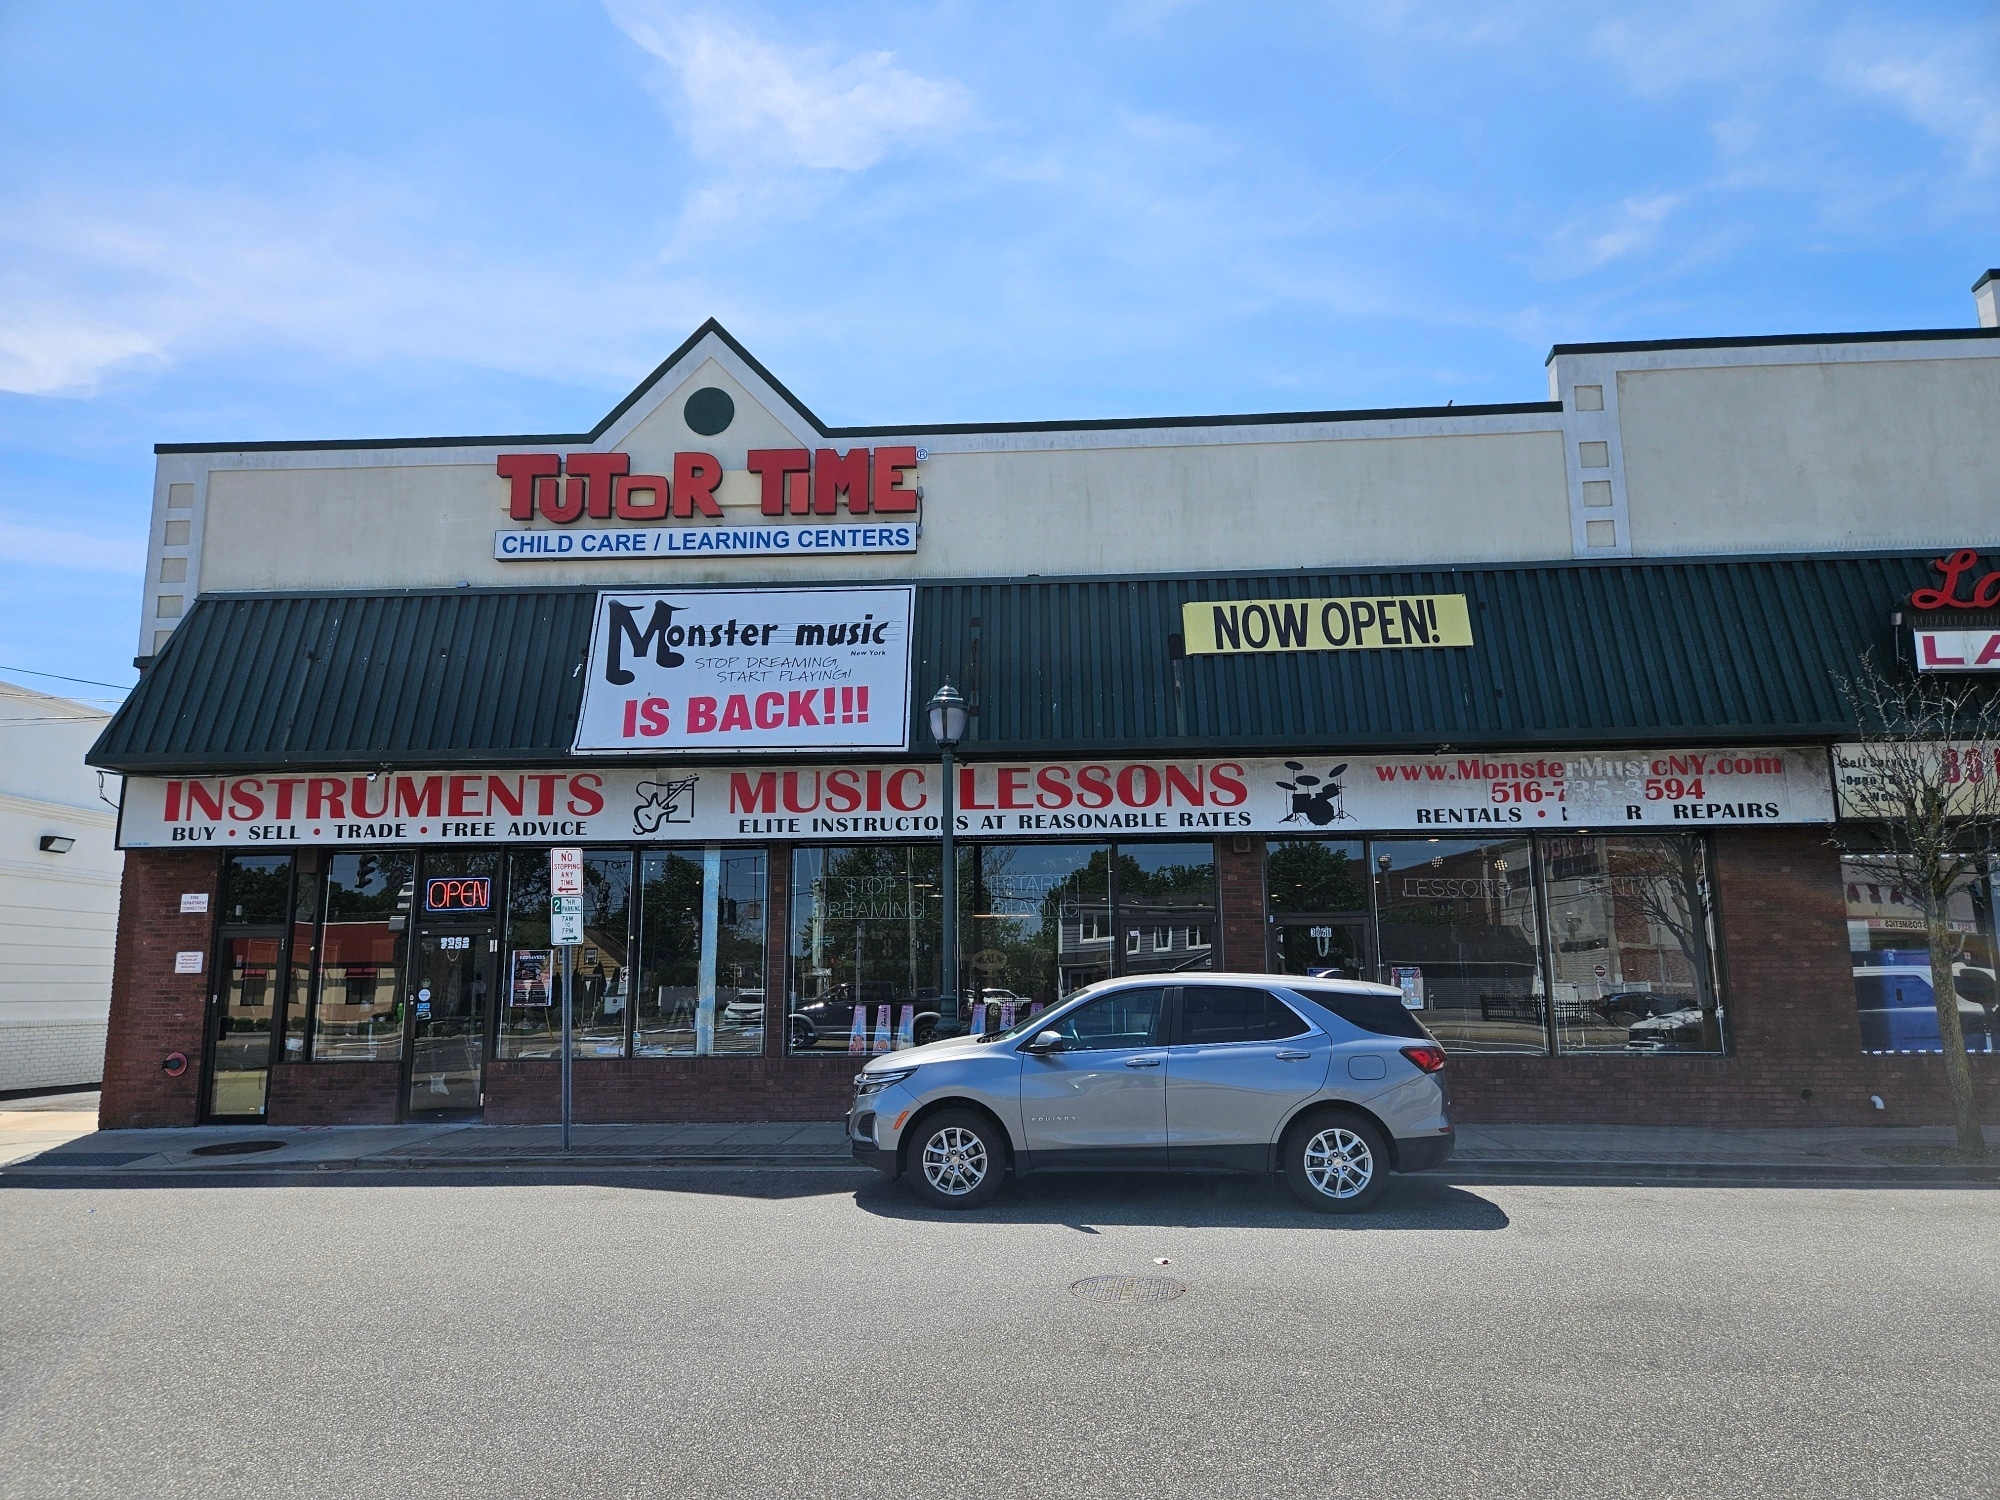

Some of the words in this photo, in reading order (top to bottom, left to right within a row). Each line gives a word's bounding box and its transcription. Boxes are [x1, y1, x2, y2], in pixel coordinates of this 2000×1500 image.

[502, 535, 574, 553] CHILD
[581, 533, 647, 552] CARE
[668, 530, 790, 551] LEARNING
[797, 527, 910, 548] CENTERS
[1213, 602, 1308, 649] NOW
[1321, 599, 1440, 646] OPEN!
[606, 600, 778, 685] Monster
[796, 614, 889, 646] music
[695, 657, 740, 669] STOP
[747, 656, 839, 671] DREAMING,
[717, 670, 773, 683] START
[779, 669, 852, 682] PLAYING!
[622, 697, 670, 738] IS
[686, 685, 869, 734] BACK!!!
[164, 773, 604, 822] INSTRUMENTS
[730, 769, 927, 814] MUSIC
[959, 763, 1248, 811] LESSONS
[739, 817, 800, 833] ELITE
[812, 815, 969, 833] INSTRUCTOS
[981, 814, 1006, 830] AT
[1018, 812, 1168, 829] REASONABLE
[1179, 810, 1251, 827] RATES
[1416, 807, 1522, 823] RENTALS
[1673, 802, 1780, 820] REPAIRS
[172, 826, 216, 841] BUY
[248, 825, 301, 840] SELL
[334, 823, 407, 839] TRADE
[441, 821, 496, 837] FREE
[507, 820, 588, 836] ADVICE
[561, 852, 573, 861] NO
[429, 881, 488, 908] OPEN
[553, 899, 561, 912] 2
